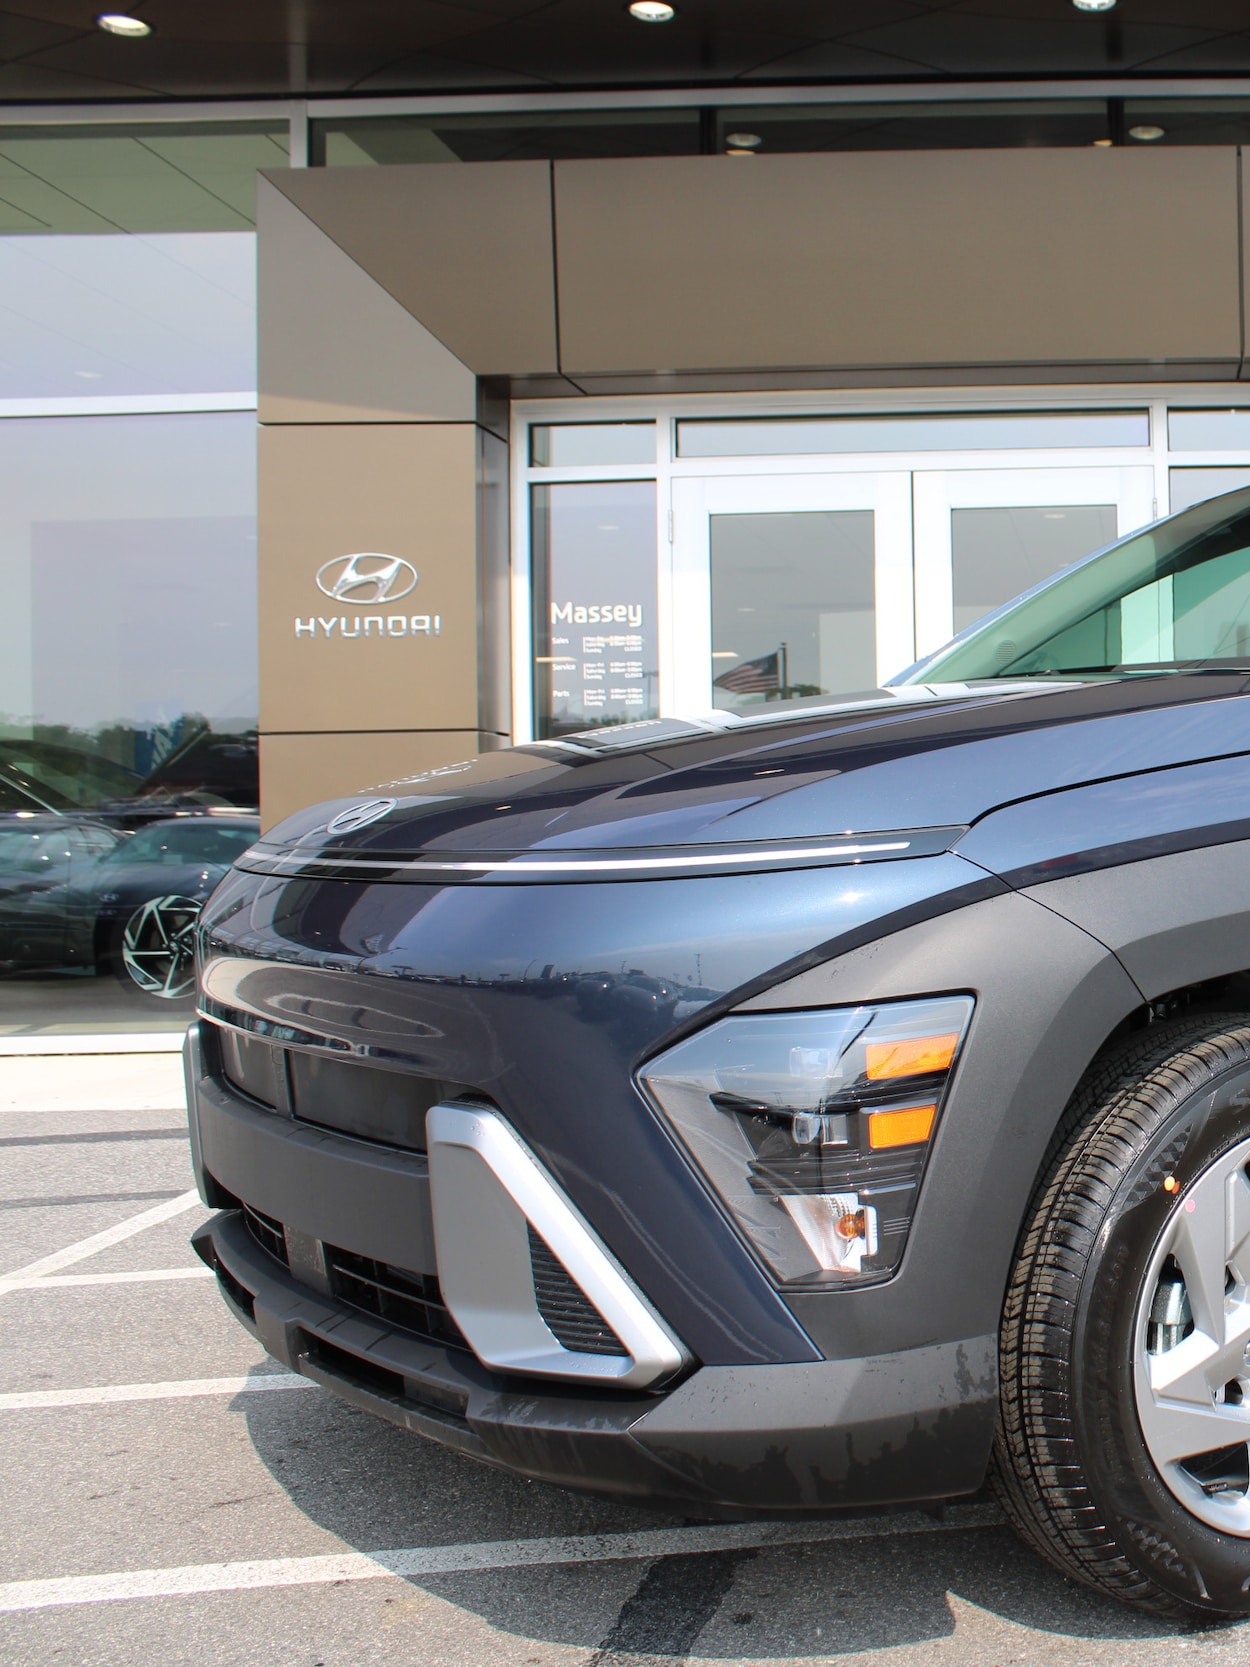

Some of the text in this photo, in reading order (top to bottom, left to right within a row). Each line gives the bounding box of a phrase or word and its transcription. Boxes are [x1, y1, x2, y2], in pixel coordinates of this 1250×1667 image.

[550, 601, 643, 627] Massey
[294, 615, 442, 638] HYUNDAI
[552, 637, 570, 645] Sales
[552, 663, 577, 671] Service
[553, 690, 571, 698] Parts
